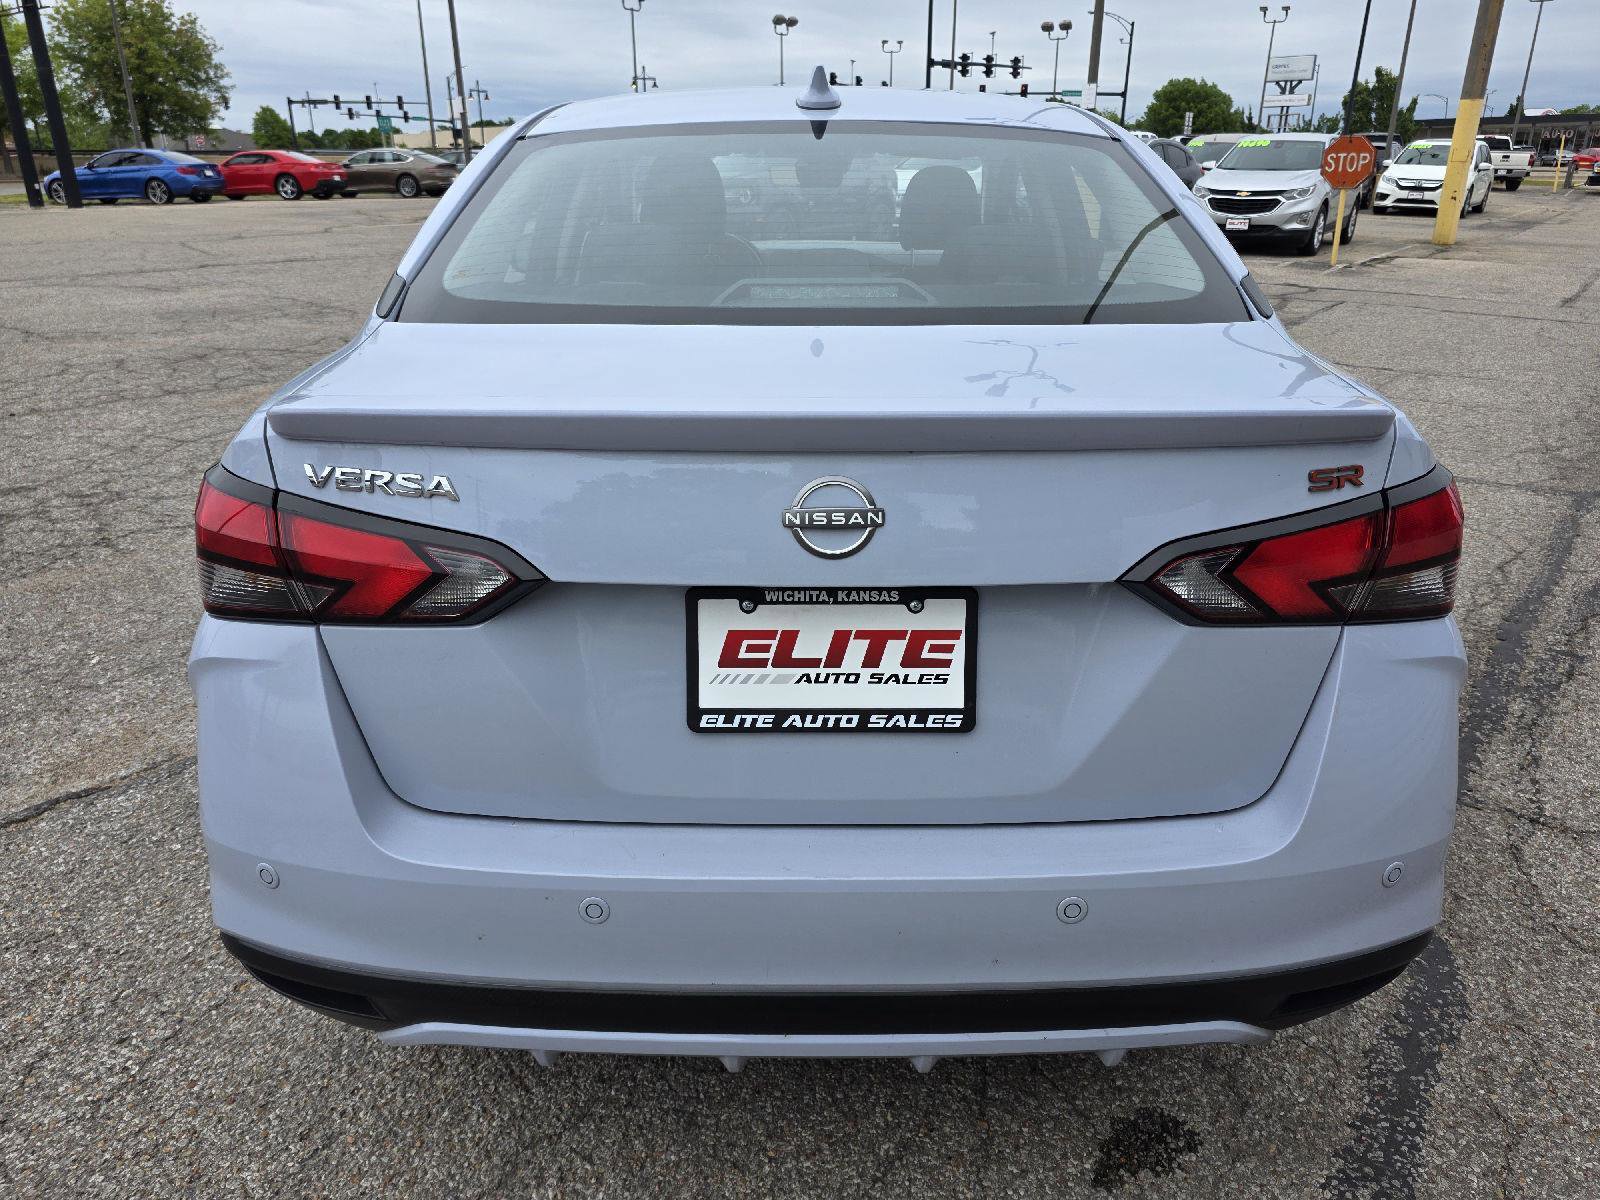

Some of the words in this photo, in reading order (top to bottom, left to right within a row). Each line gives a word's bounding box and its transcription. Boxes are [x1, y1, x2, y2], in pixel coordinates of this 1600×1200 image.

[1541, 128, 1575, 139] AUTO
[1325, 152, 1370, 172] STOP
[303, 463, 460, 502] VERSA
[1308, 465, 1364, 492] SR
[785, 511, 883, 525] NISSAN
[765, 590, 833, 604] WICHITA,
[837, 590, 900, 602] KANSAS
[717, 629, 963, 669] ELITE
[794, 672, 861, 685] AUTO
[867, 672, 951, 685] SALES
[700, 714, 775, 728] ELITE
[782, 714, 860, 728] AUTO
[867, 714, 964, 728] SALES
